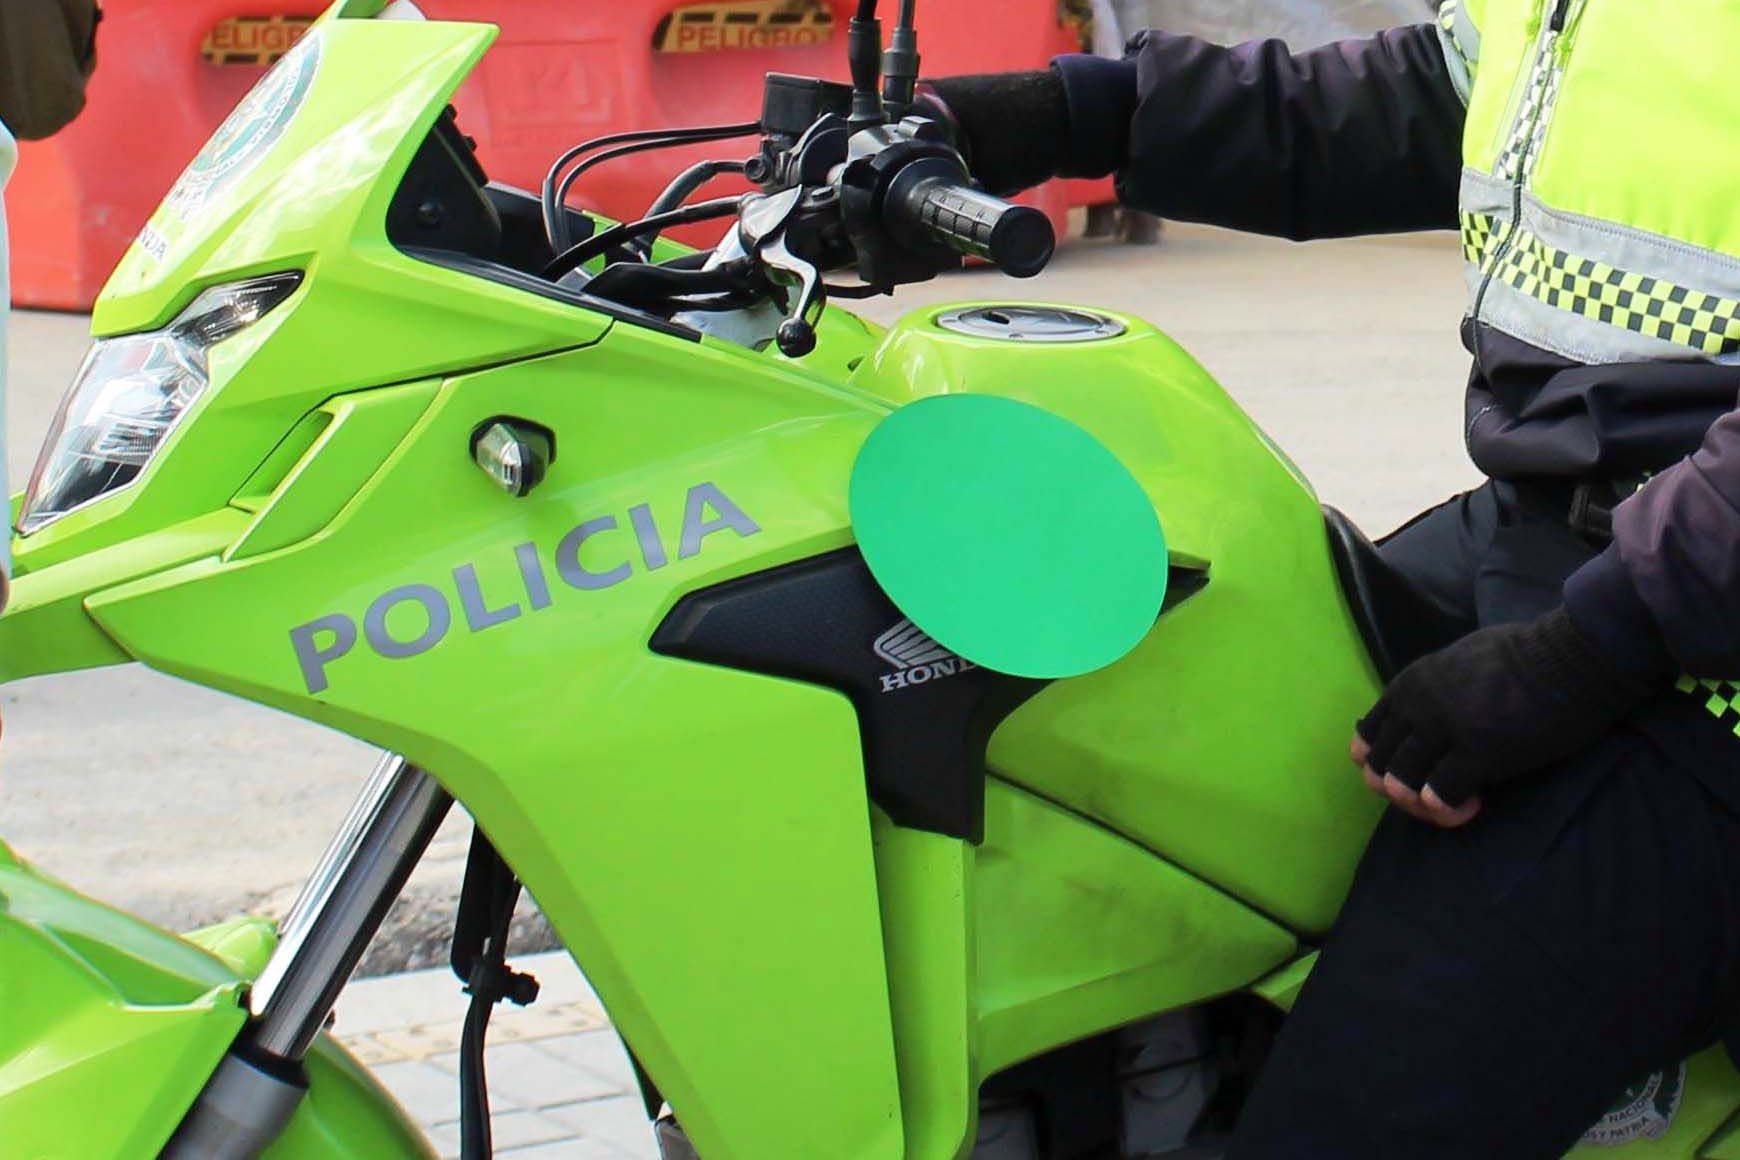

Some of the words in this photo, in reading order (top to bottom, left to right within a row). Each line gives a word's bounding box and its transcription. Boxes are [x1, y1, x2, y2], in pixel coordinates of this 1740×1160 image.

[676, 24, 818, 50] PELIGRO
[288, 481, 763, 695] POLICIA
[879, 659, 978, 693] HON
